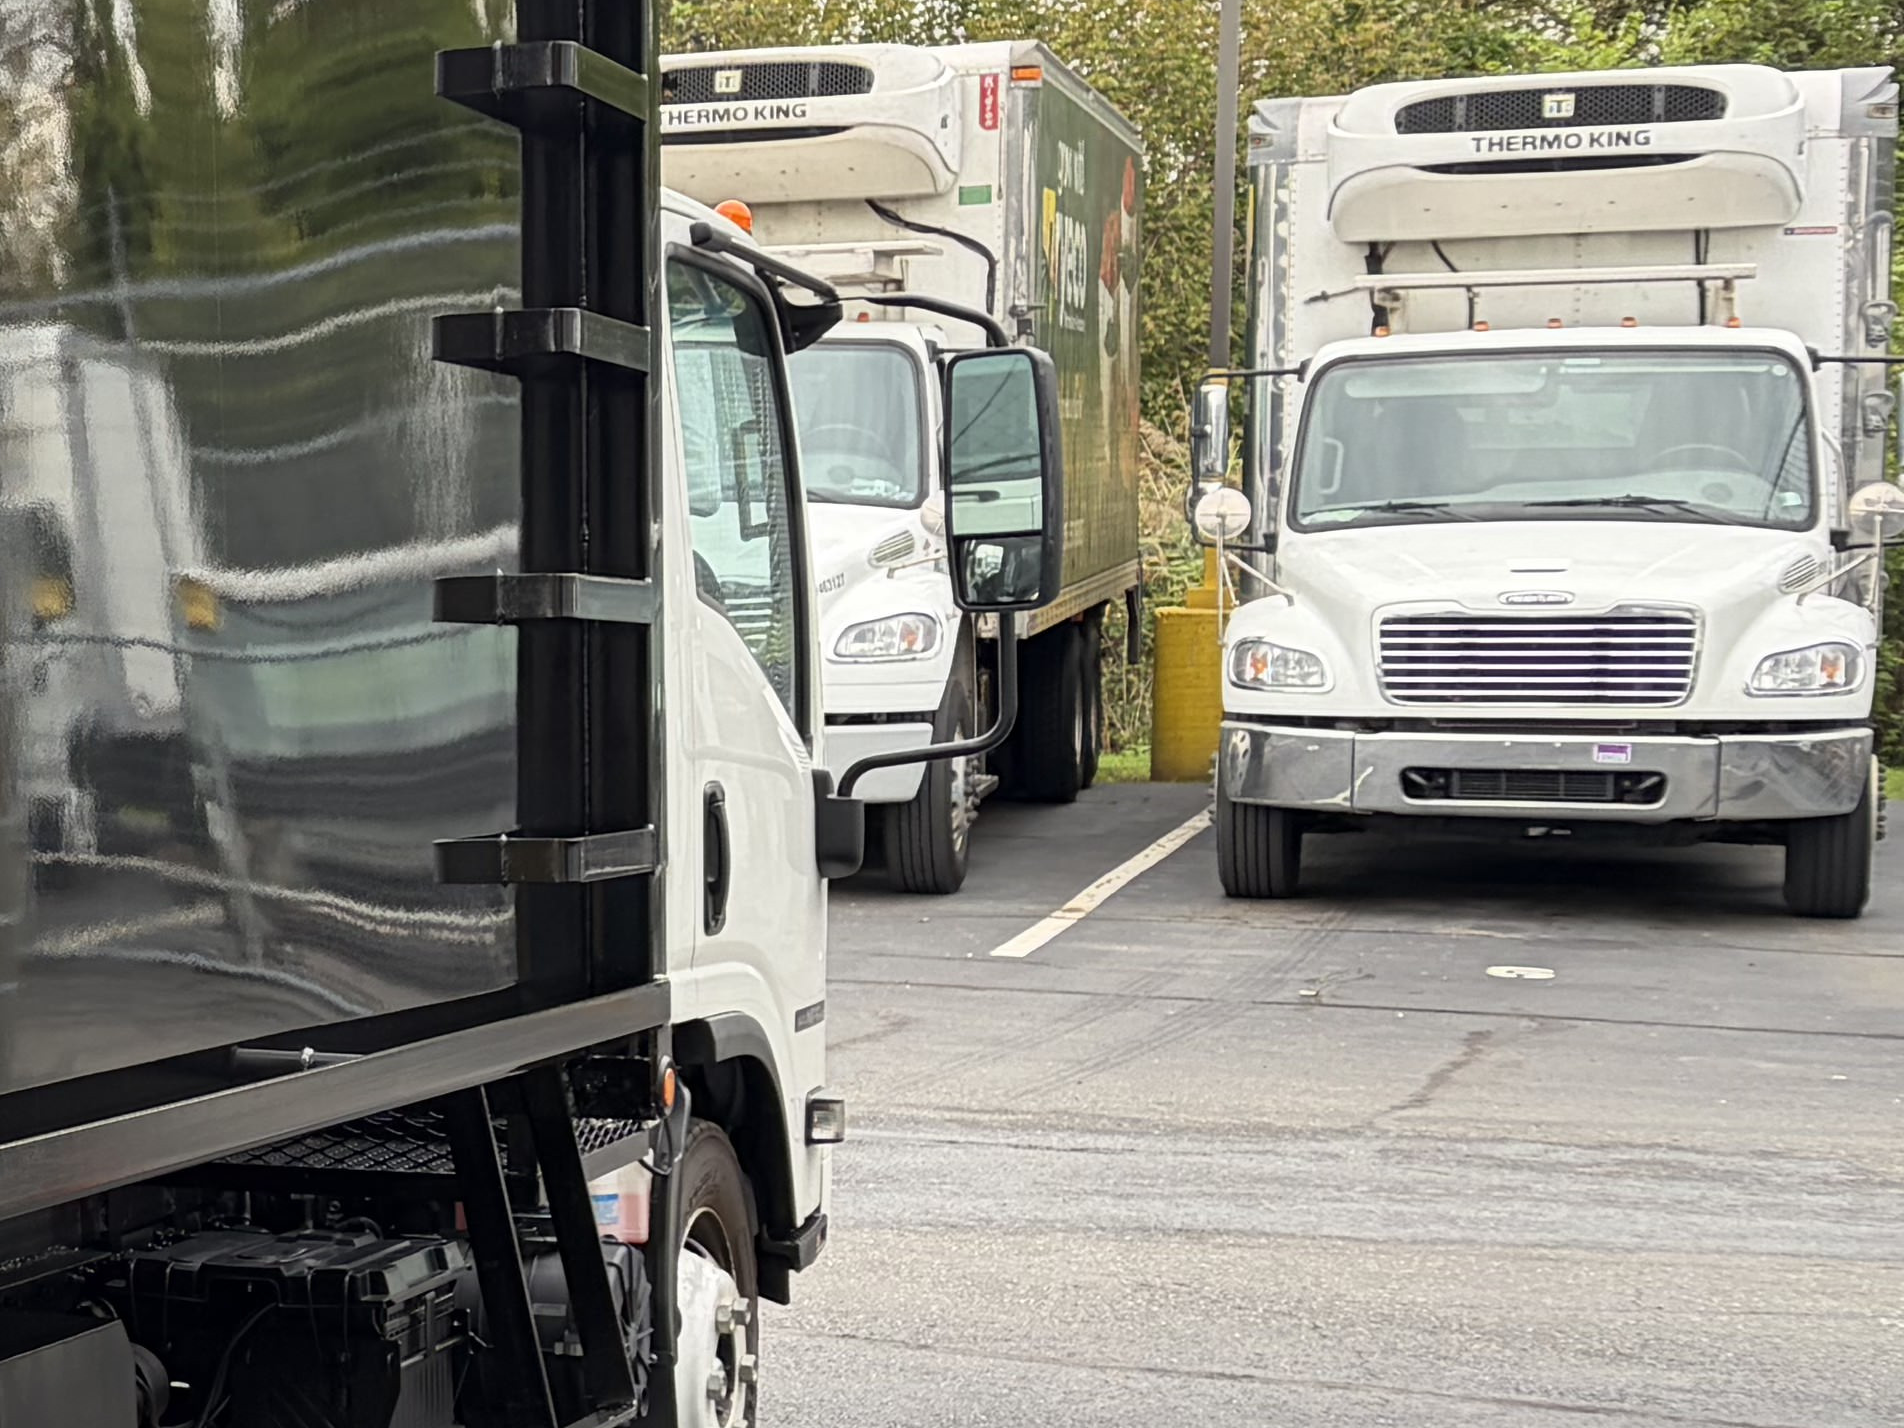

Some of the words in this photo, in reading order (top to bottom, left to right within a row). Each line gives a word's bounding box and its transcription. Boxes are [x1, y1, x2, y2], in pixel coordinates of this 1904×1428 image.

[663, 107, 748, 125] HERMO
[754, 103, 807, 121] KING
[1472, 133, 1582, 153] THERMO
[1589, 130, 1651, 148] KING
